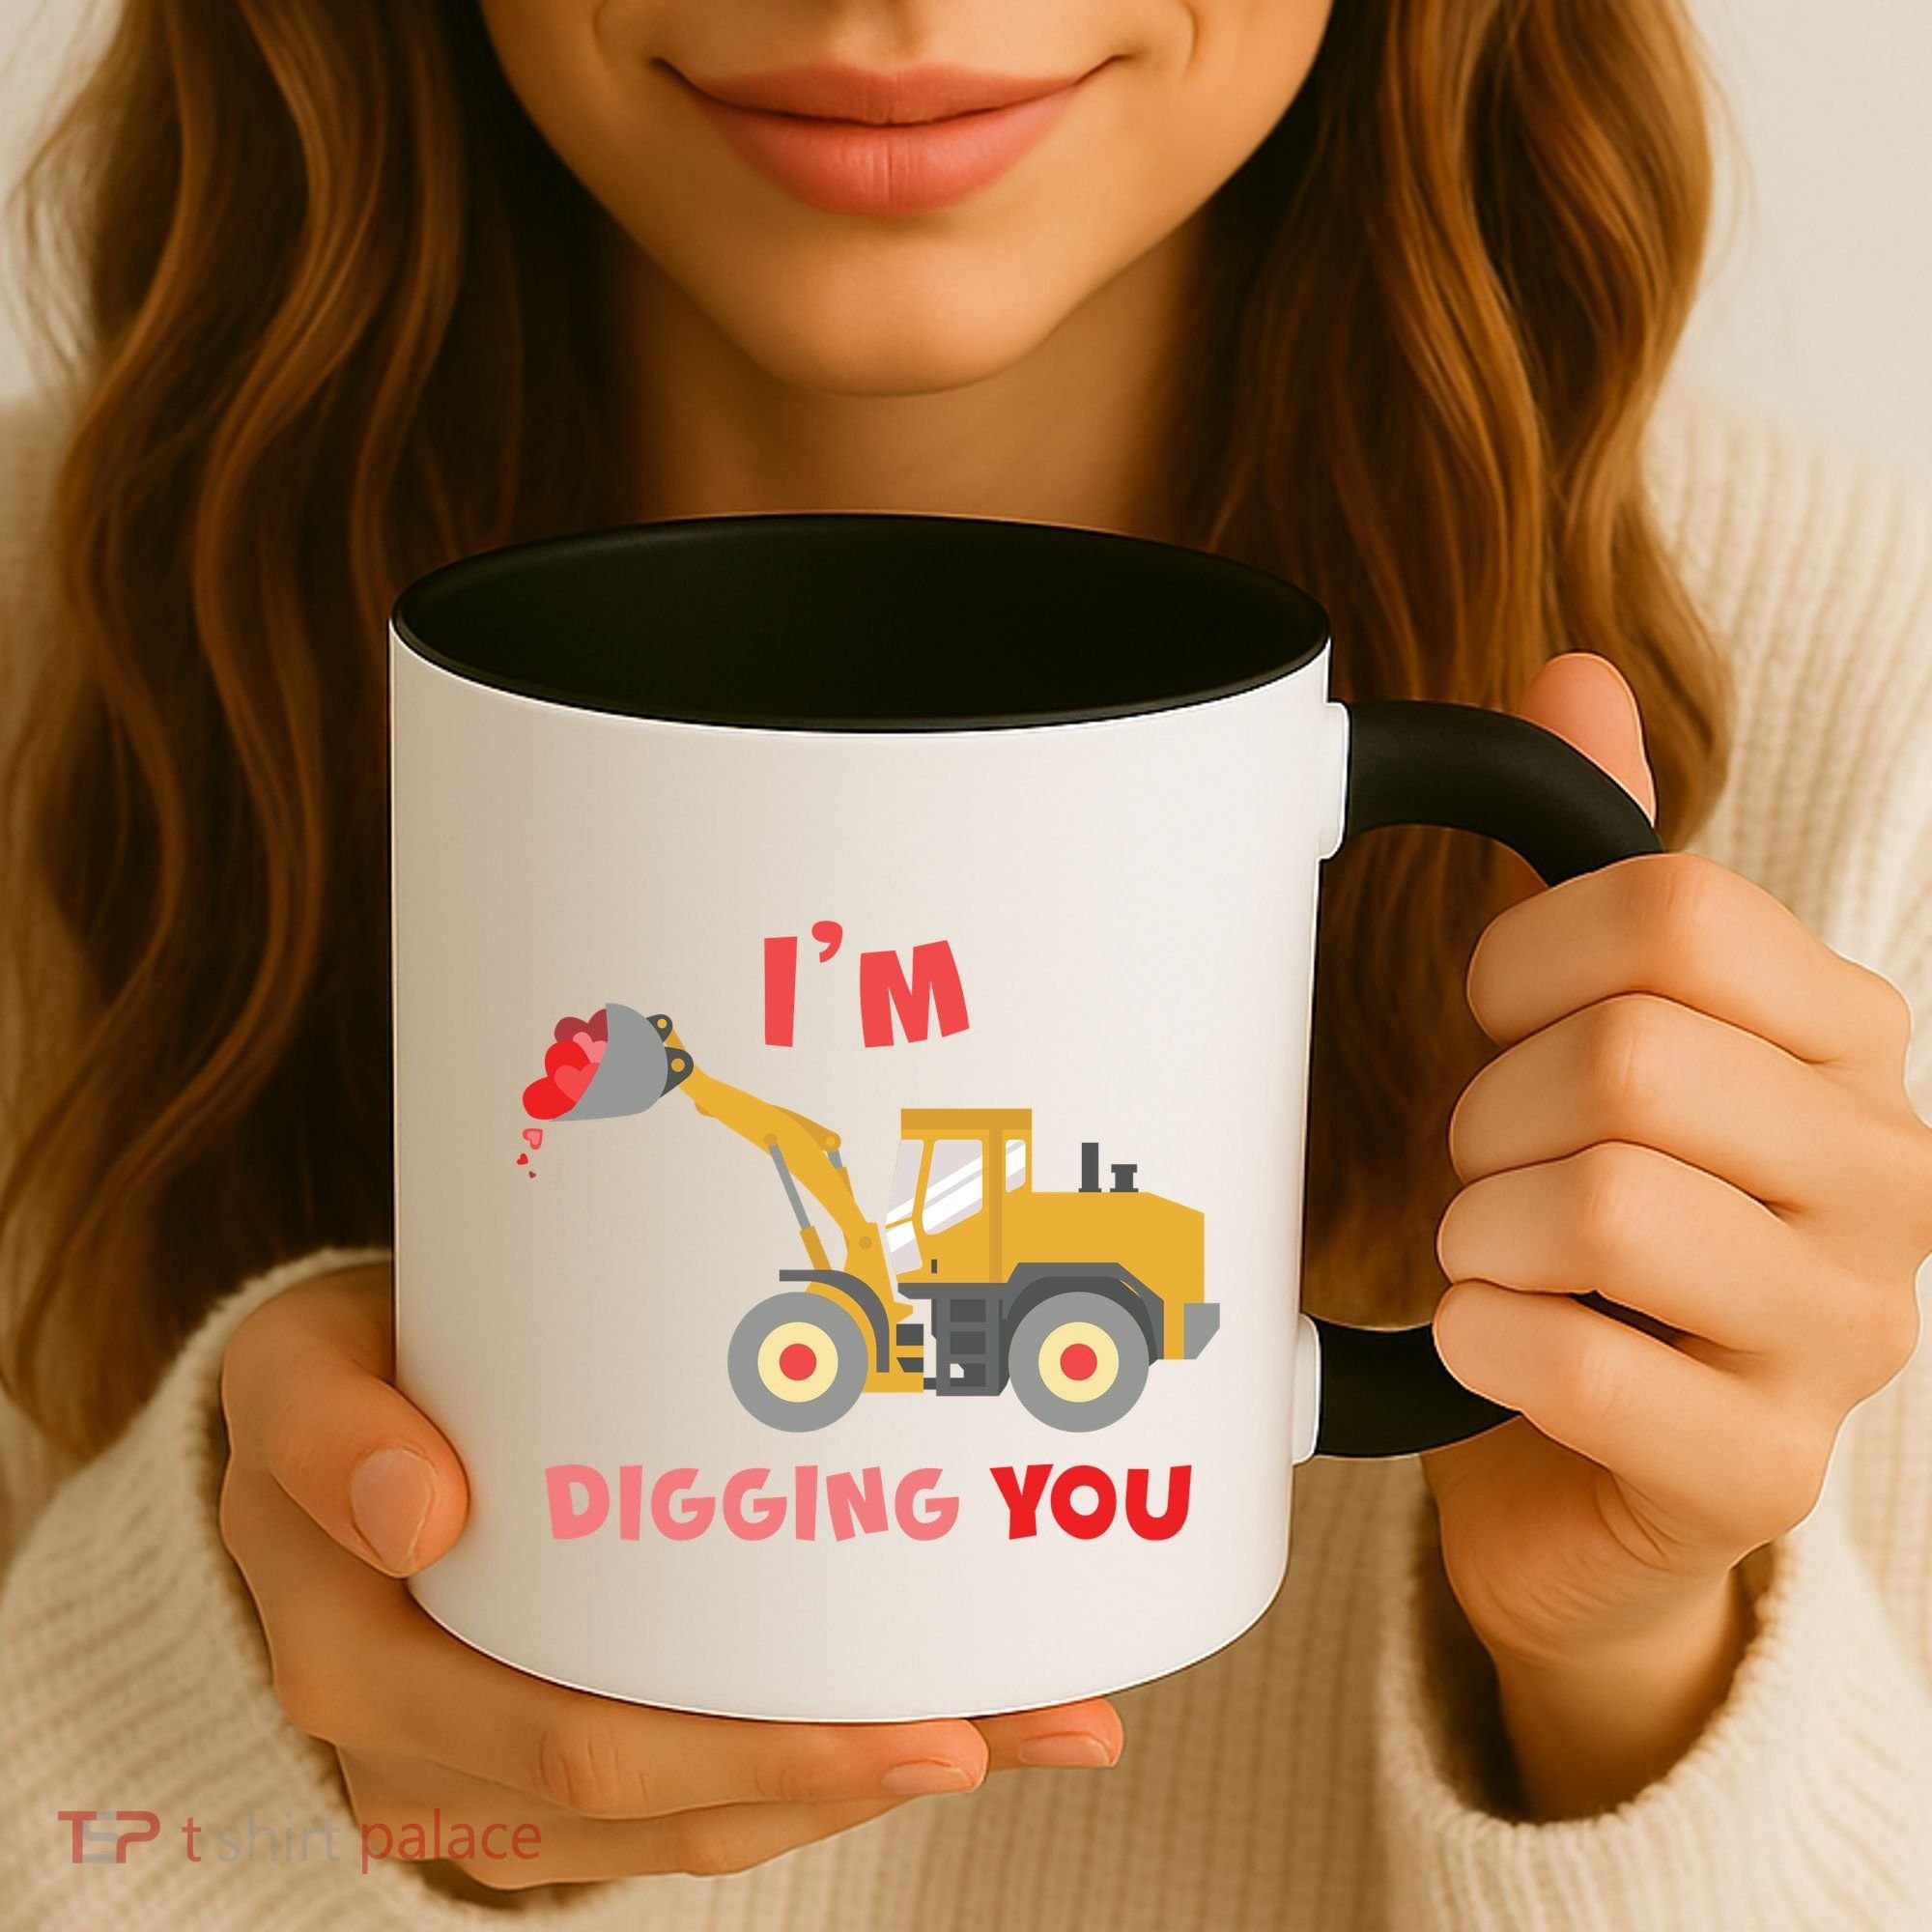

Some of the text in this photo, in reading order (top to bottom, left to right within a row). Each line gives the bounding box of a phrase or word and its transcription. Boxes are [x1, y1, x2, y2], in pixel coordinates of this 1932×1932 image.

[763, 919, 971, 1049] I'M
[545, 1463, 1193, 1542] DIGGING YOU
